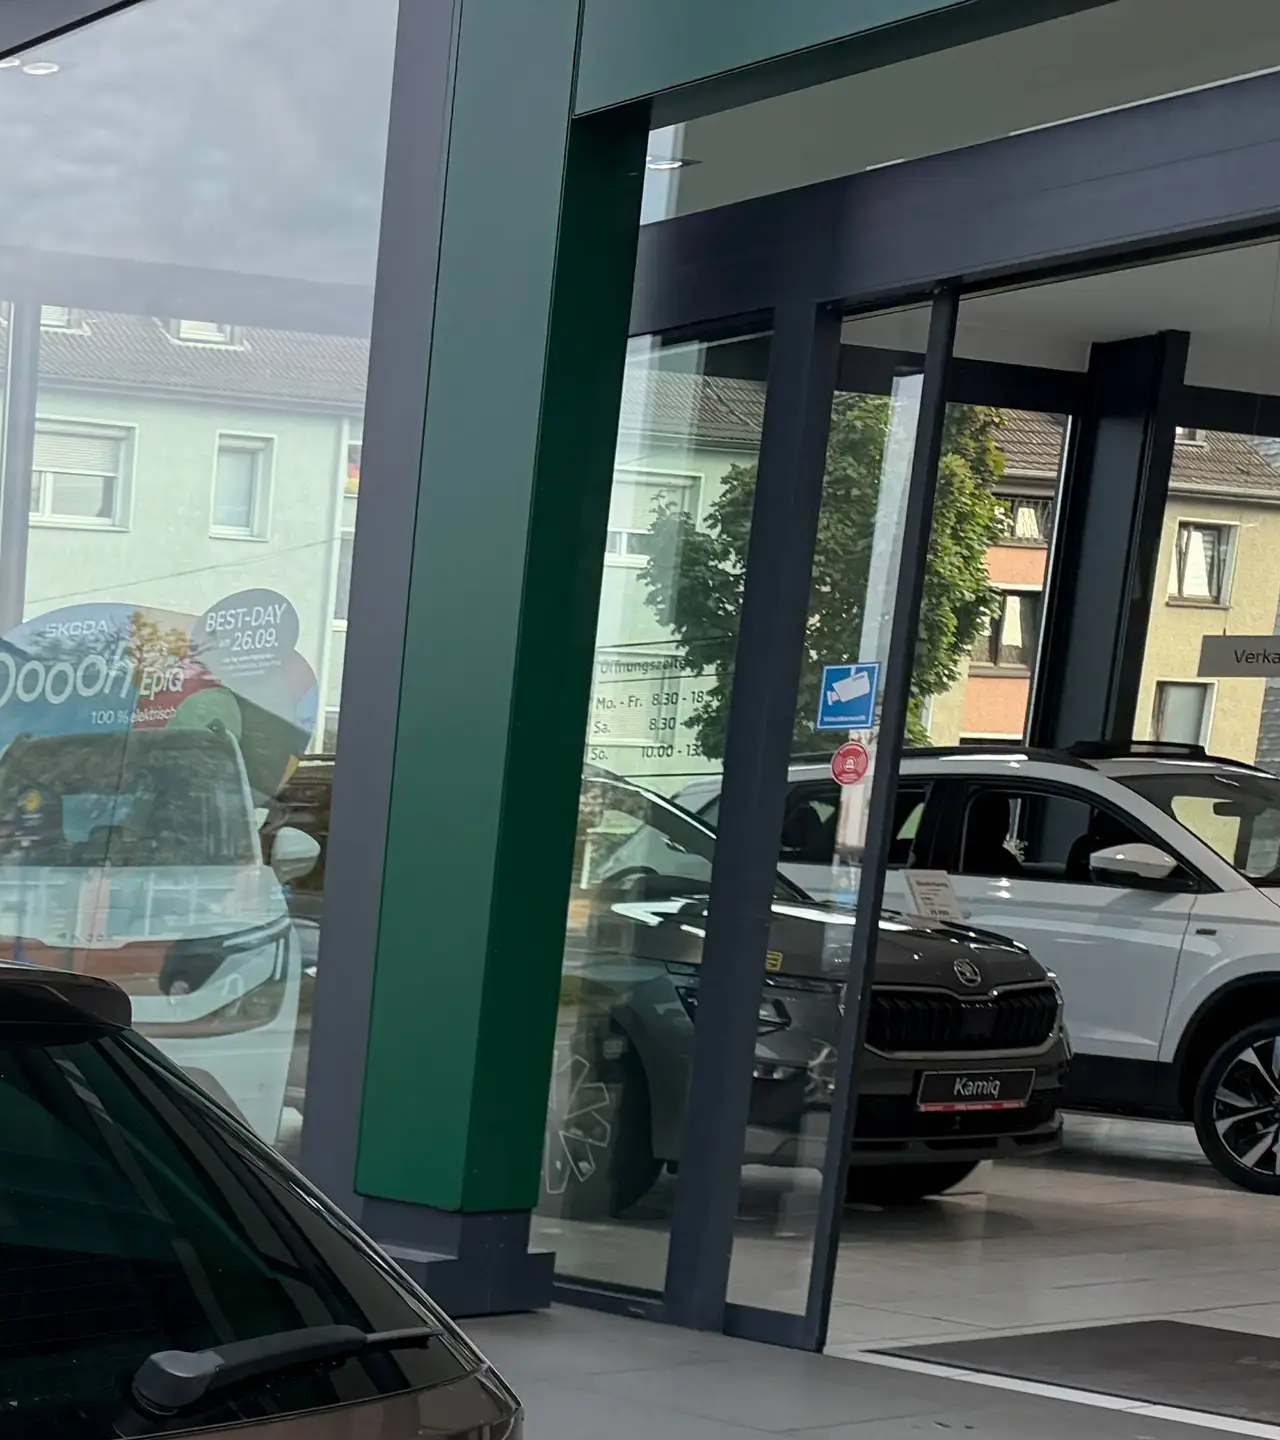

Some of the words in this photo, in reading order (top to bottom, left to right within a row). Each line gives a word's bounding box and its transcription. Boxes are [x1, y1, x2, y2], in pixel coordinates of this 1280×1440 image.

[205, 602, 288, 633] BEST-DAY
[230, 628, 279, 652] 26.09.
[1234, 648, 1280, 664] Verka
[599, 658, 687, 675] Öffnungszeite
[596, 696, 617, 710] Mo.
[627, 694, 643, 708] Fr.
[90, 710, 115, 725] 100
[594, 720, 611, 735] Sa.
[590, 748, 609, 761] So.
[641, 745, 674, 758] 10.00
[953, 1076, 1001, 1098] Kamiq
